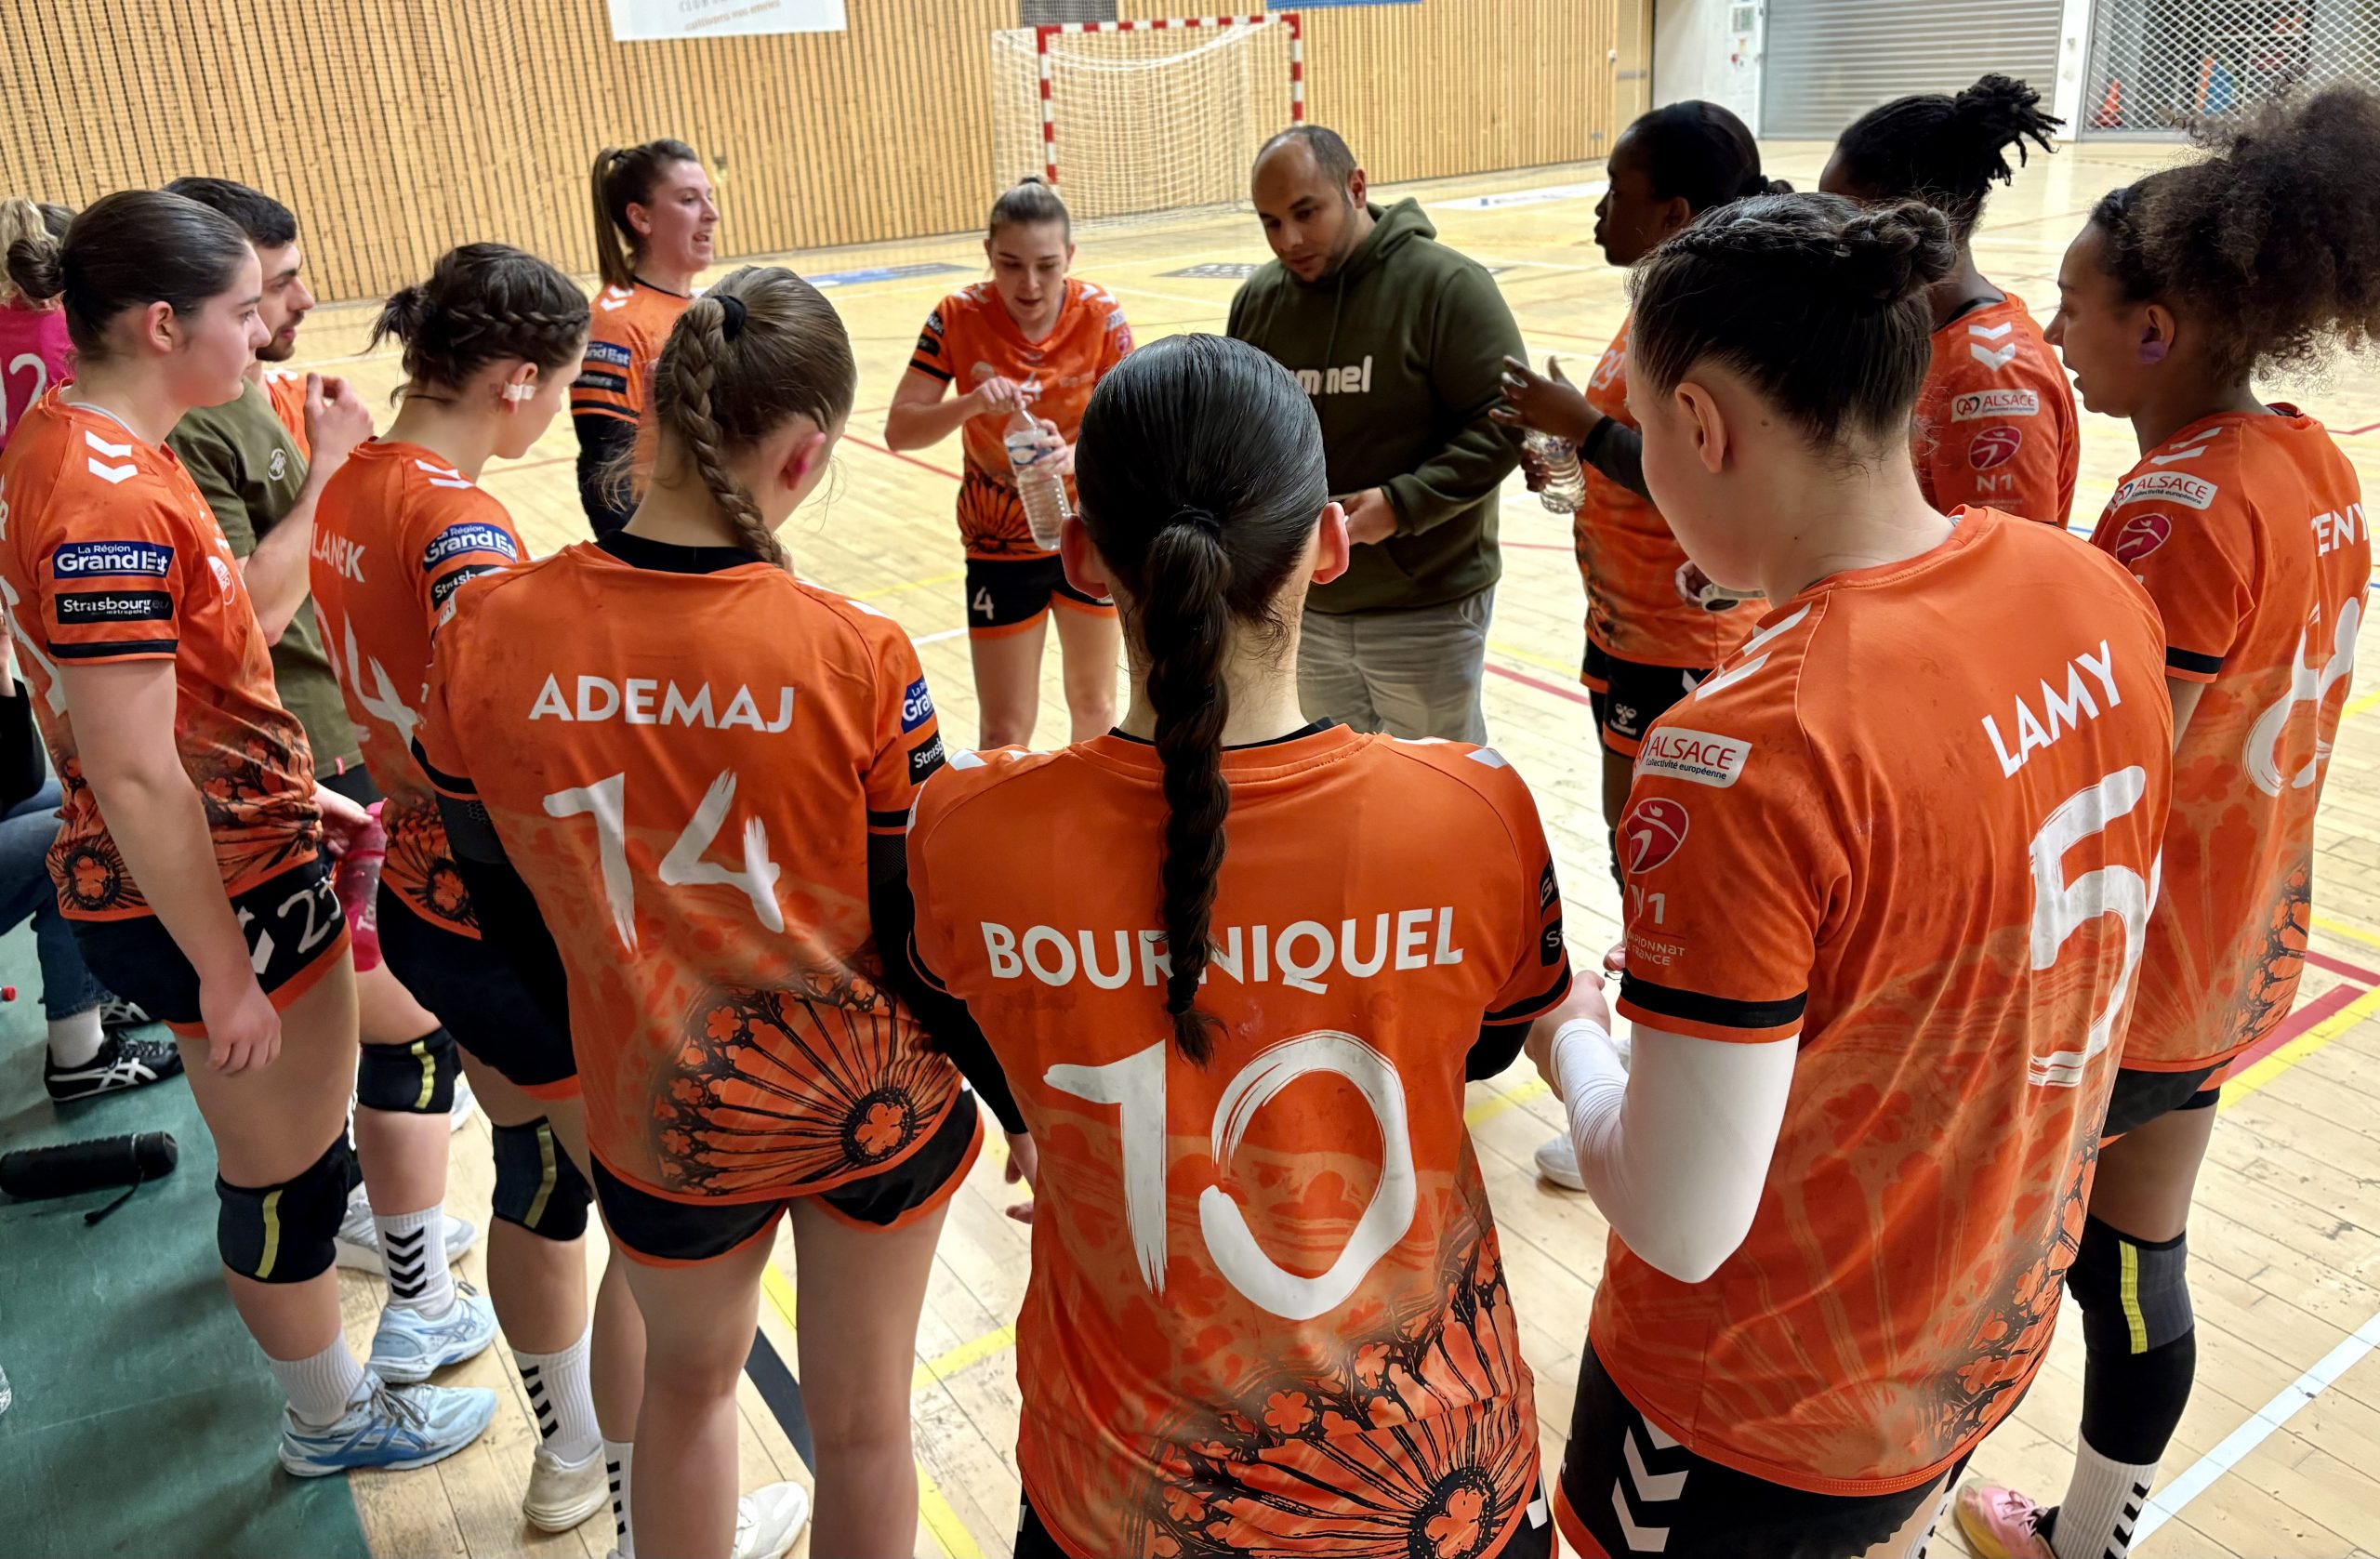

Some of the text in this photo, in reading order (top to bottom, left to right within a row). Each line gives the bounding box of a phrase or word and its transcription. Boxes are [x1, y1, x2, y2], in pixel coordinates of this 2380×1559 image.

[1290, 355, 1372, 395] mmel
[1983, 394, 2035, 407] ALSACE
[1977, 473, 2014, 492] N1
[2135, 475, 2208, 500] ALSACE
[57, 550, 139, 572] Grand
[77, 544, 131, 554] La Région
[424, 532, 518, 562] Grand Es
[973, 586, 995, 620] 4
[528, 672, 794, 733] ADEMAJ
[1981, 640, 2121, 779] LAMY
[1648, 736, 1737, 771] ALSACE
[1679, 763, 1727, 780] européenne
[543, 766, 785, 954] 14
[2029, 765, 2162, 1088] 5
[981, 906, 1464, 995] BOURNIQUEL
[1042, 1029, 1417, 1320] 10
